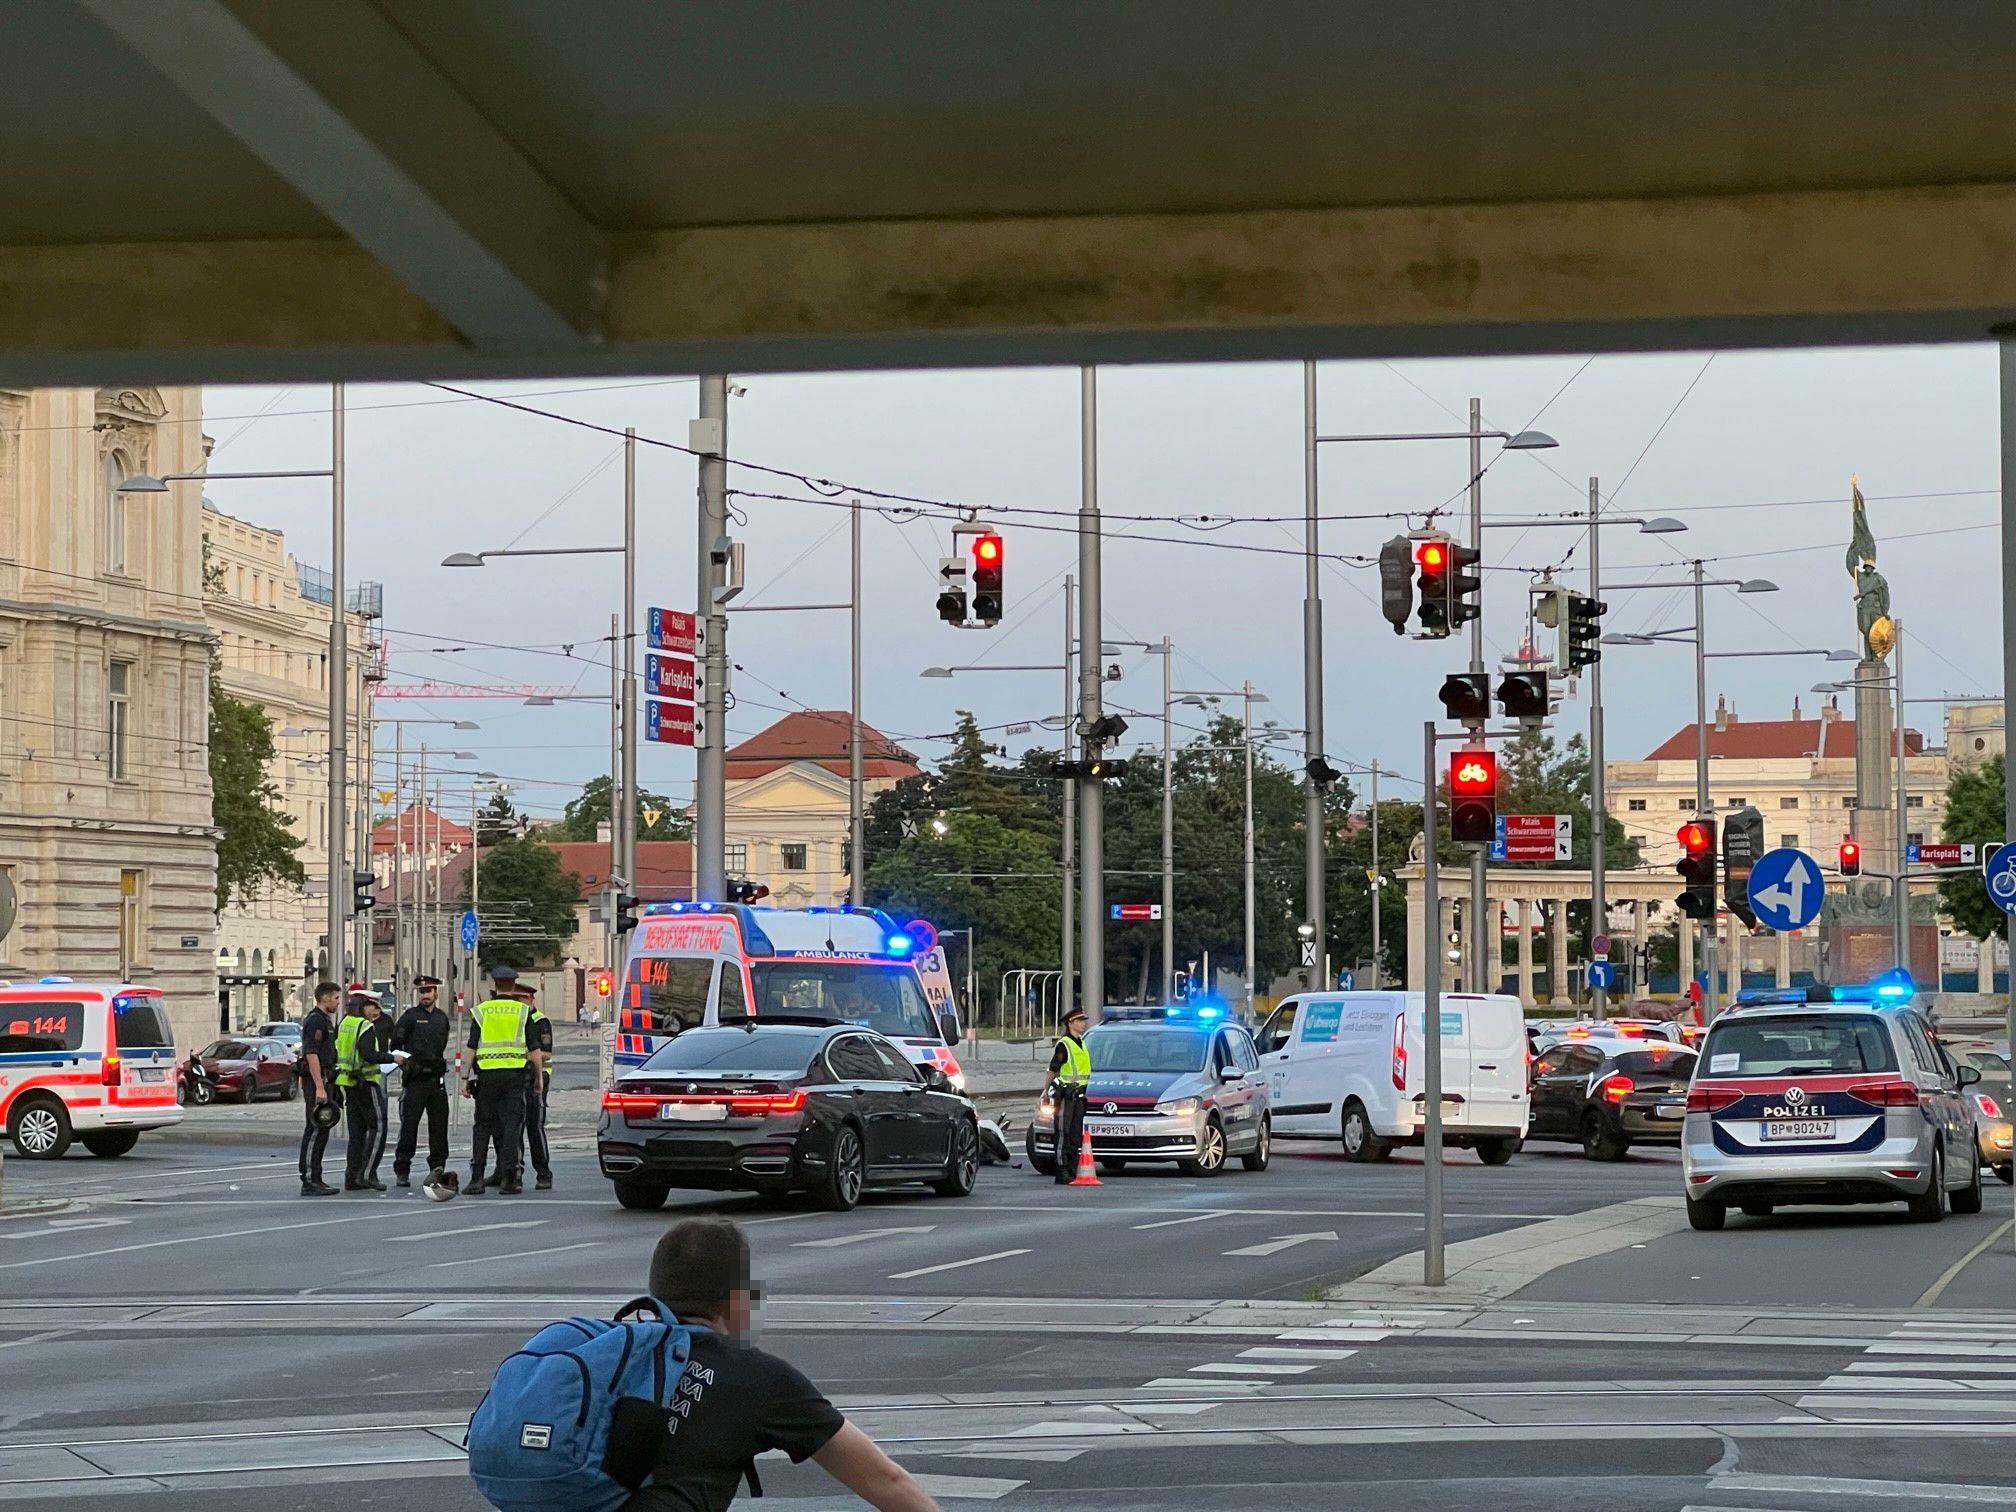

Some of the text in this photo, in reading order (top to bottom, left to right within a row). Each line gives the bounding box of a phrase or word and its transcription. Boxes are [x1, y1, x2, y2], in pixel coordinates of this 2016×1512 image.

[660, 666, 693, 692] Karlsplatz
[1521, 817, 1540, 826] Palais
[1507, 827, 1555, 836] Schwarzenberg
[1920, 849, 1960, 860] Karlsplatz
[644, 925, 723, 950] BERUFSRETTUNG
[794, 950, 871, 960] AMBULANCE
[33, 1016, 67, 1034] 144
[1763, 1105, 1826, 1117] POLIZEI
[1106, 1125, 1130, 1134] 91254
[1771, 1122, 1829, 1135] BP 90247
